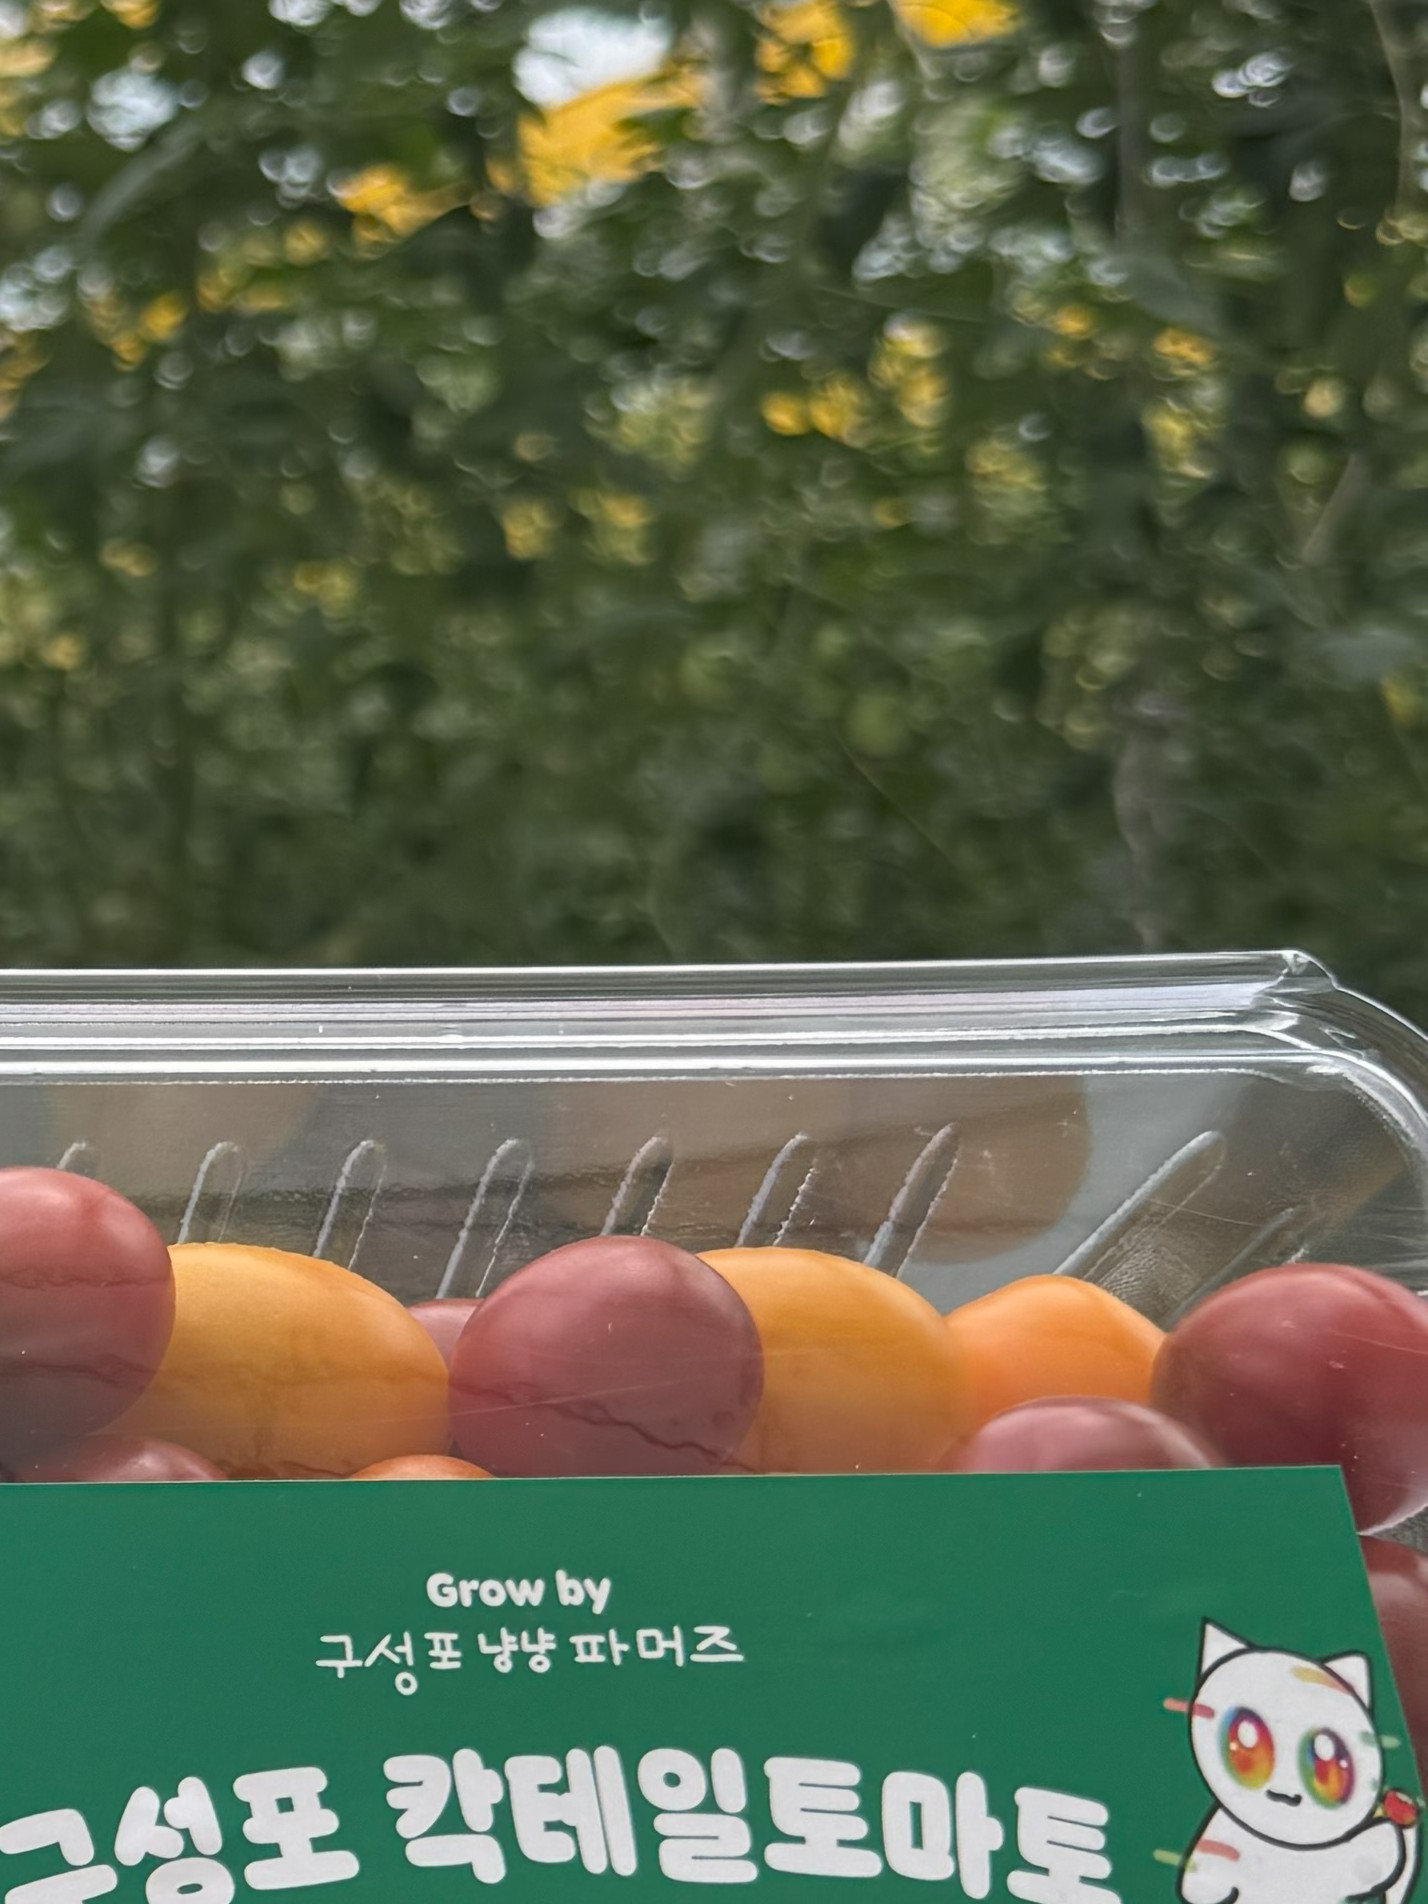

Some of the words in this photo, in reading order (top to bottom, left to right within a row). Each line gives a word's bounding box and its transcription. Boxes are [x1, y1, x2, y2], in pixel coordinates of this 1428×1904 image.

[427, 1573, 545, 1607] Grow
[556, 1570, 611, 1614] by
[316, 1632, 461, 1695] 구성포
[478, 1627, 556, 1673] 냥냥
[569, 1626, 744, 1666] 파머즈
